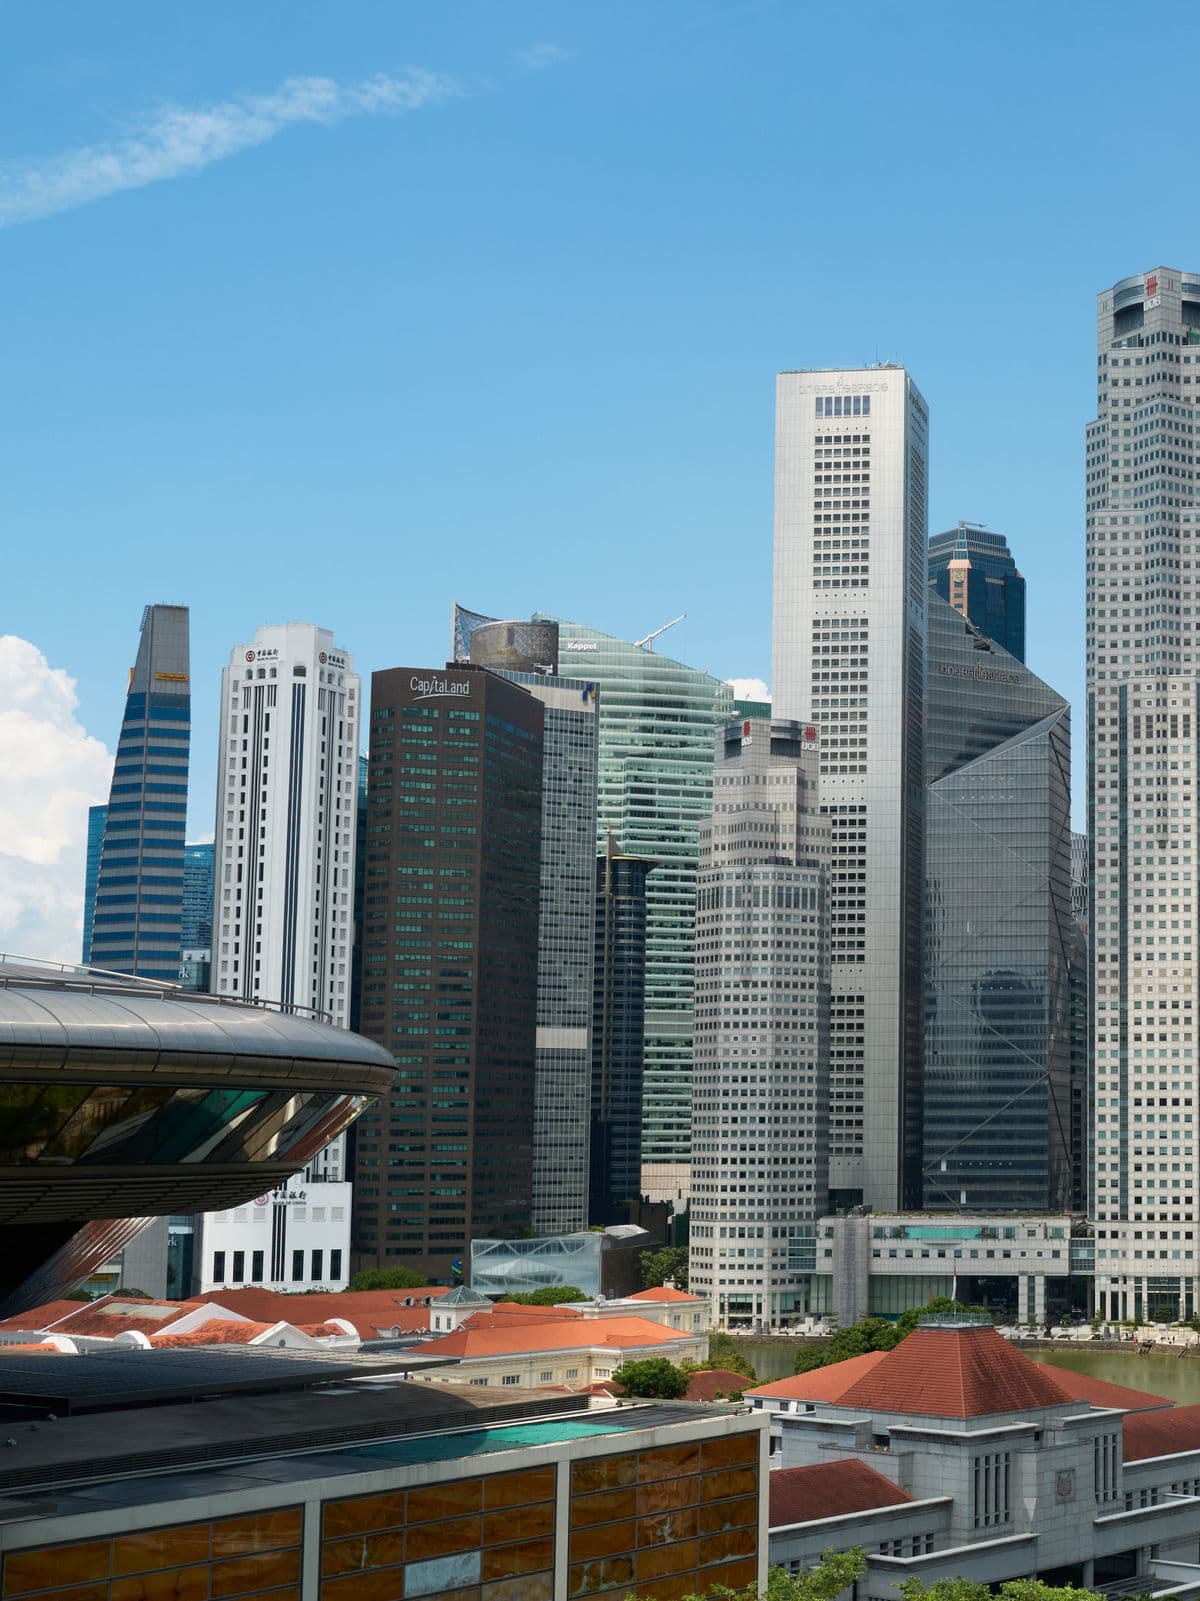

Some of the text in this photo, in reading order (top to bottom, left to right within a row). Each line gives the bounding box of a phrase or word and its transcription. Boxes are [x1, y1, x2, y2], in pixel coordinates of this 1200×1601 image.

[1143, 296, 1161, 311] UOB
[567, 641, 597, 650] Keppel
[410, 676, 470, 695] CapitaLand
[801, 741, 819, 752] UOB
